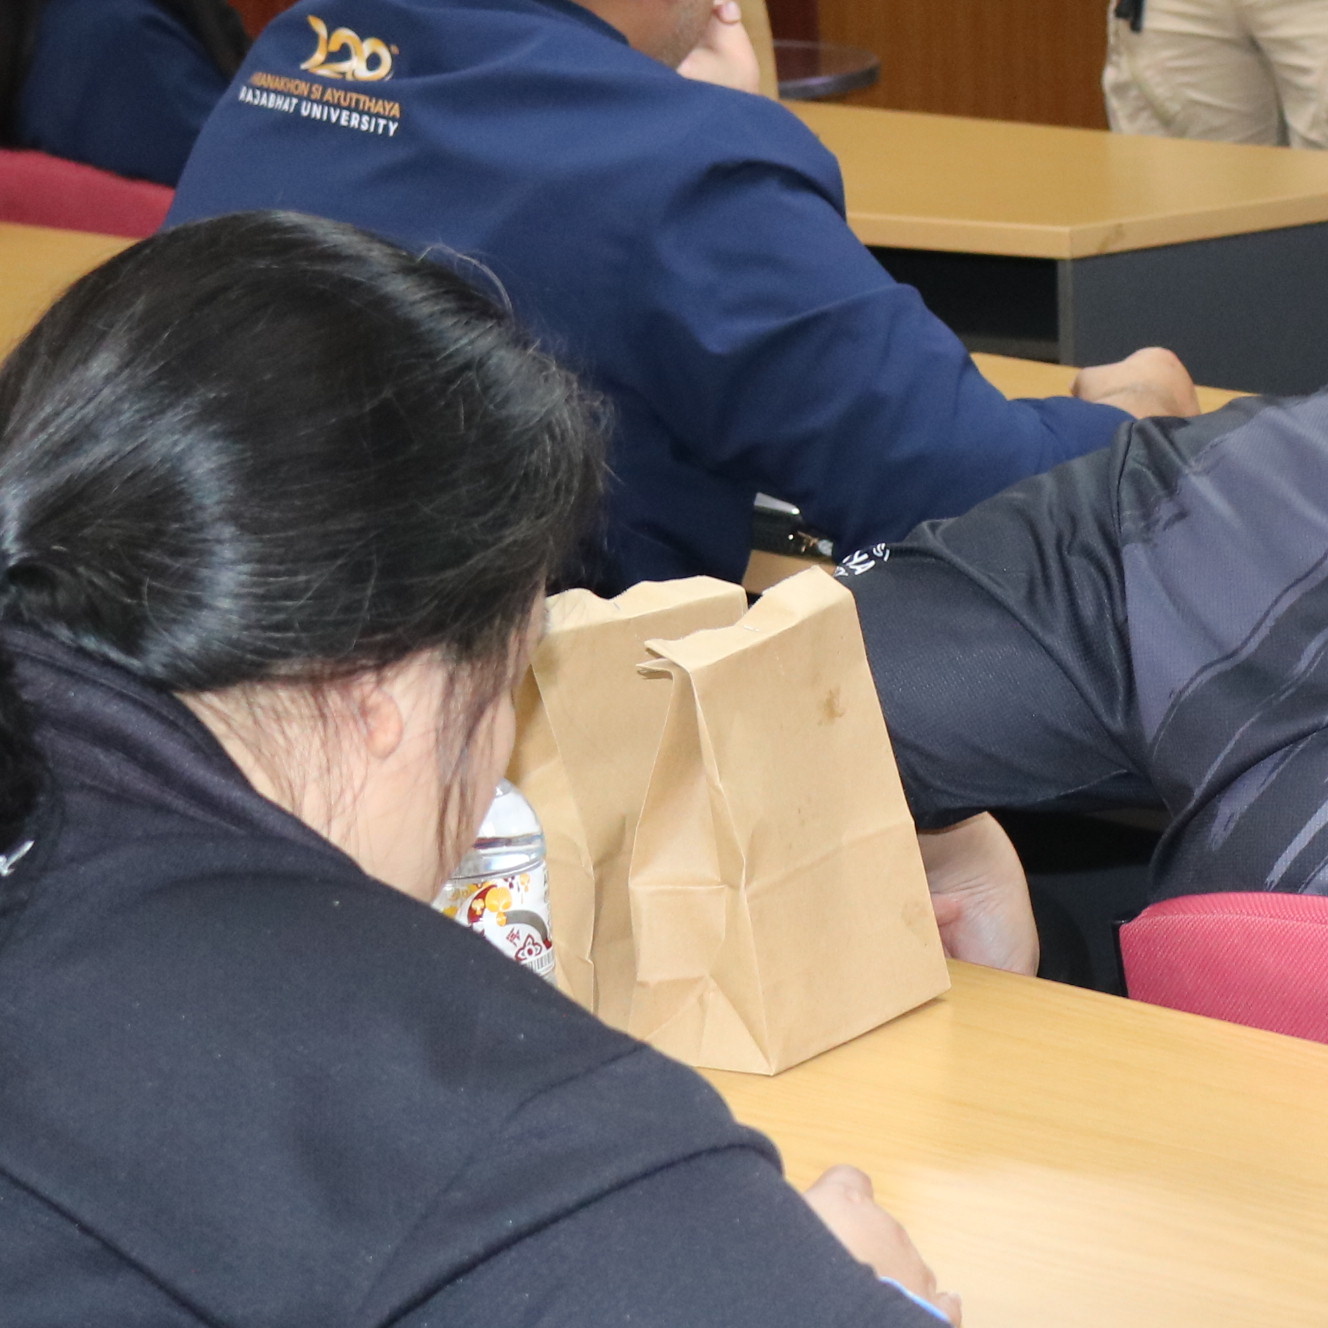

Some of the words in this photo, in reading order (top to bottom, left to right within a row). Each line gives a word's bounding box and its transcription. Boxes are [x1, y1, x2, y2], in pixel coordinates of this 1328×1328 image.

[238, 85, 298, 114] RAJABHAT
[300, 100, 400, 138] UNIVERSITY
[323, 86, 401, 119] AYUTTHAYA
